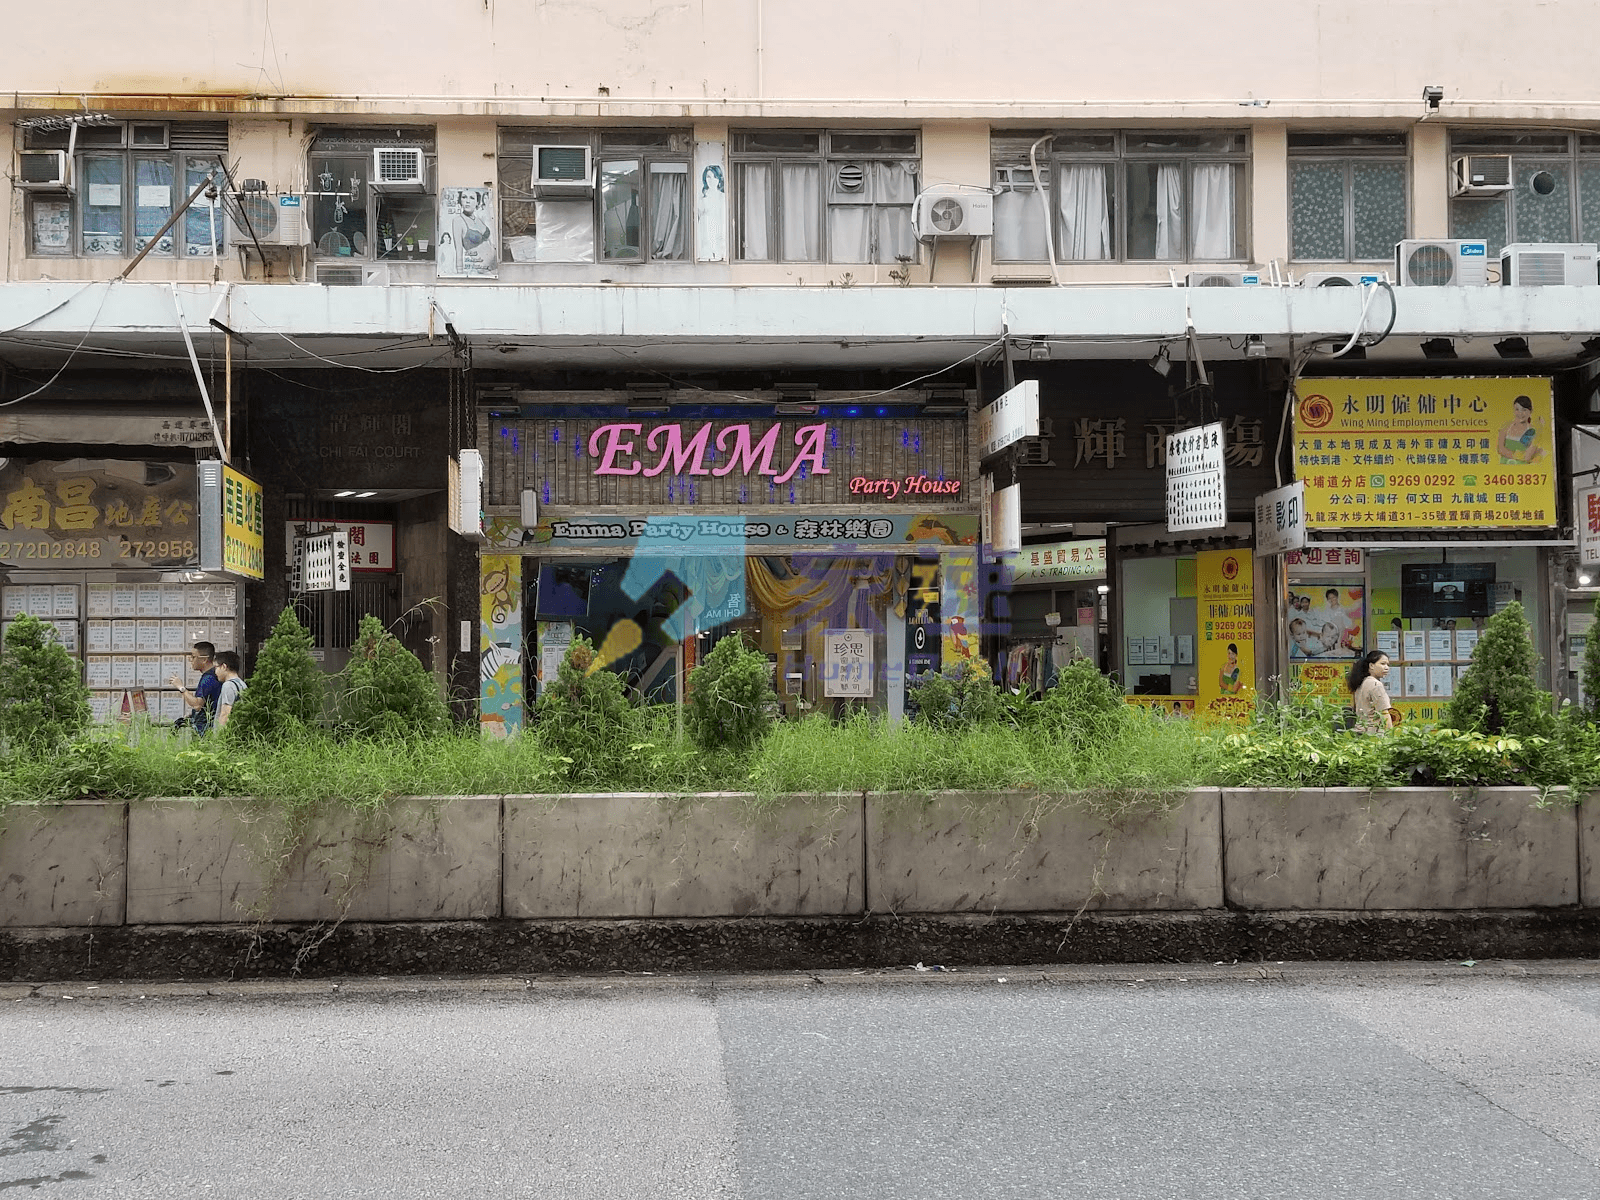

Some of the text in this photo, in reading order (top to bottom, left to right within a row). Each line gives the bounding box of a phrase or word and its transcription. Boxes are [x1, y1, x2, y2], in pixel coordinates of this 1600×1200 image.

[1341, 417, 1488, 428] Wing Ming Employment Services
[320, 446, 420, 458] CHI FAI COURT
[588, 422, 830, 484] EMMA
[849, 475, 961, 499] Party House
[1389, 474, 1420, 487] 9269
[1424, 474, 1455, 486] 0292
[1483, 474, 1515, 486] 3460
[1517, 473, 1547, 486] 3837
[226, 475, 261, 534] 南昌地產
[1406, 493, 1443, 504] 何文田
[1451, 492, 1488, 504] 九龍城
[1495, 492, 1519, 504] 旺角
[552, 520, 893, 541] Emma Party House & 森林樂園
[0, 541, 101, 559] 27202848
[1031, 546, 1106, 566] 基盛貿易公司
[1285, 548, 1360, 565] 歡迎查詢
[1586, 549, 1599, 560] TEL
[1049, 565, 1082, 576] TRADING
[1215, 621, 1253, 630] 9269 029
[1215, 631, 1253, 640] 3460 383
